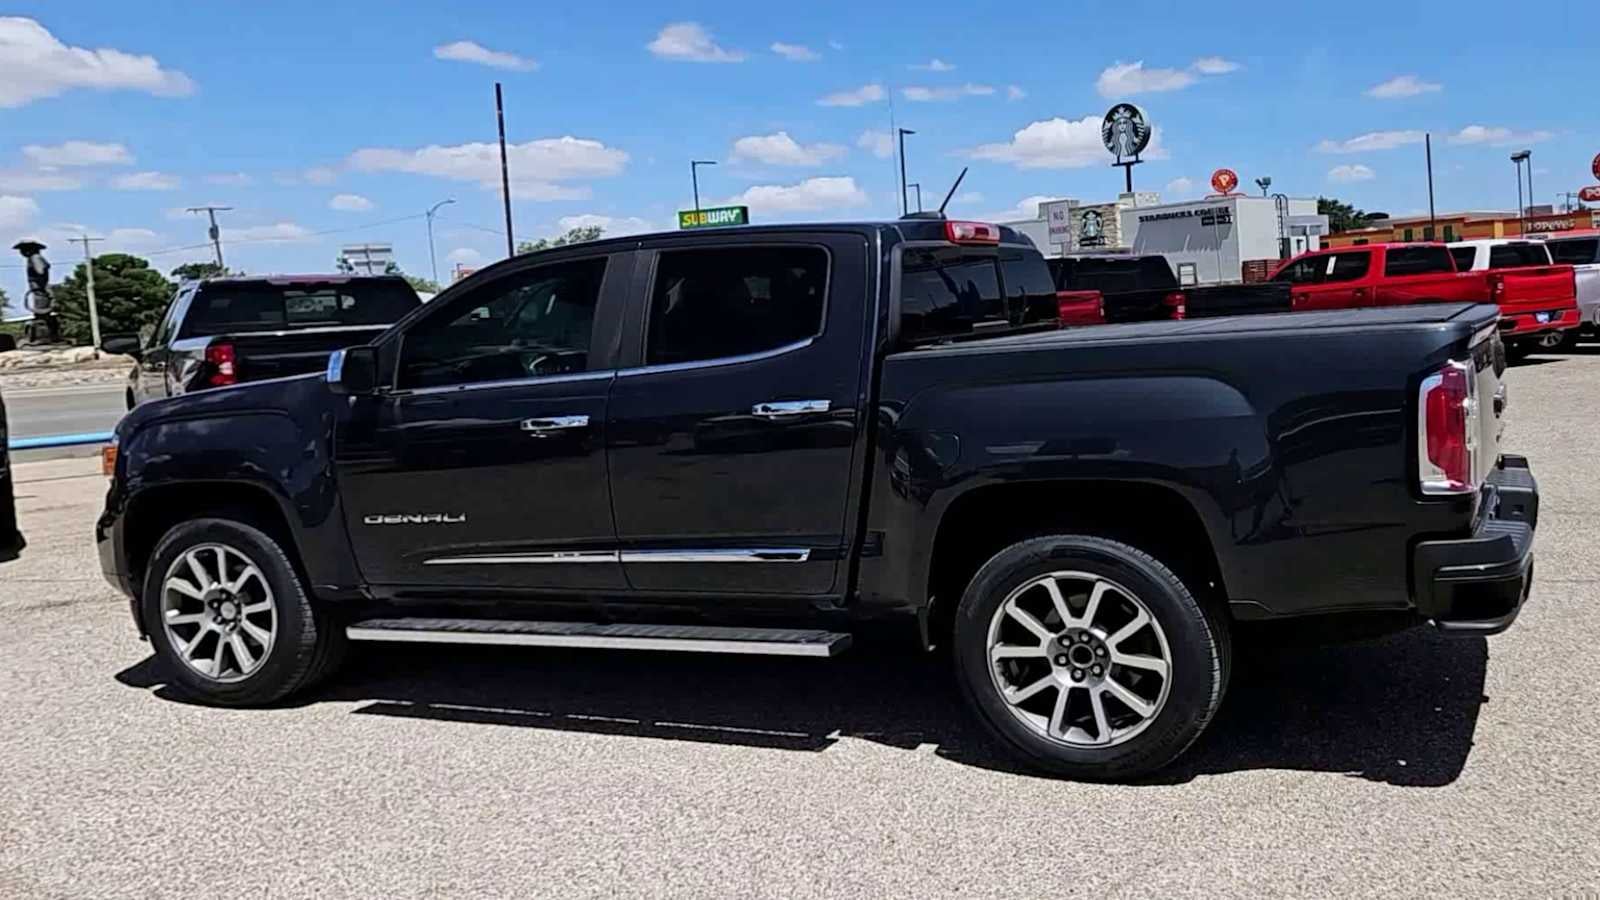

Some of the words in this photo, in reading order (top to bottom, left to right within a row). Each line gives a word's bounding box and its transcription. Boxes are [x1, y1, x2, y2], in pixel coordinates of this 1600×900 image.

[682, 209, 740, 226] SUBWAY
[1138, 210, 1194, 223] STARBUCKS
[364, 513, 466, 524] DENALI
